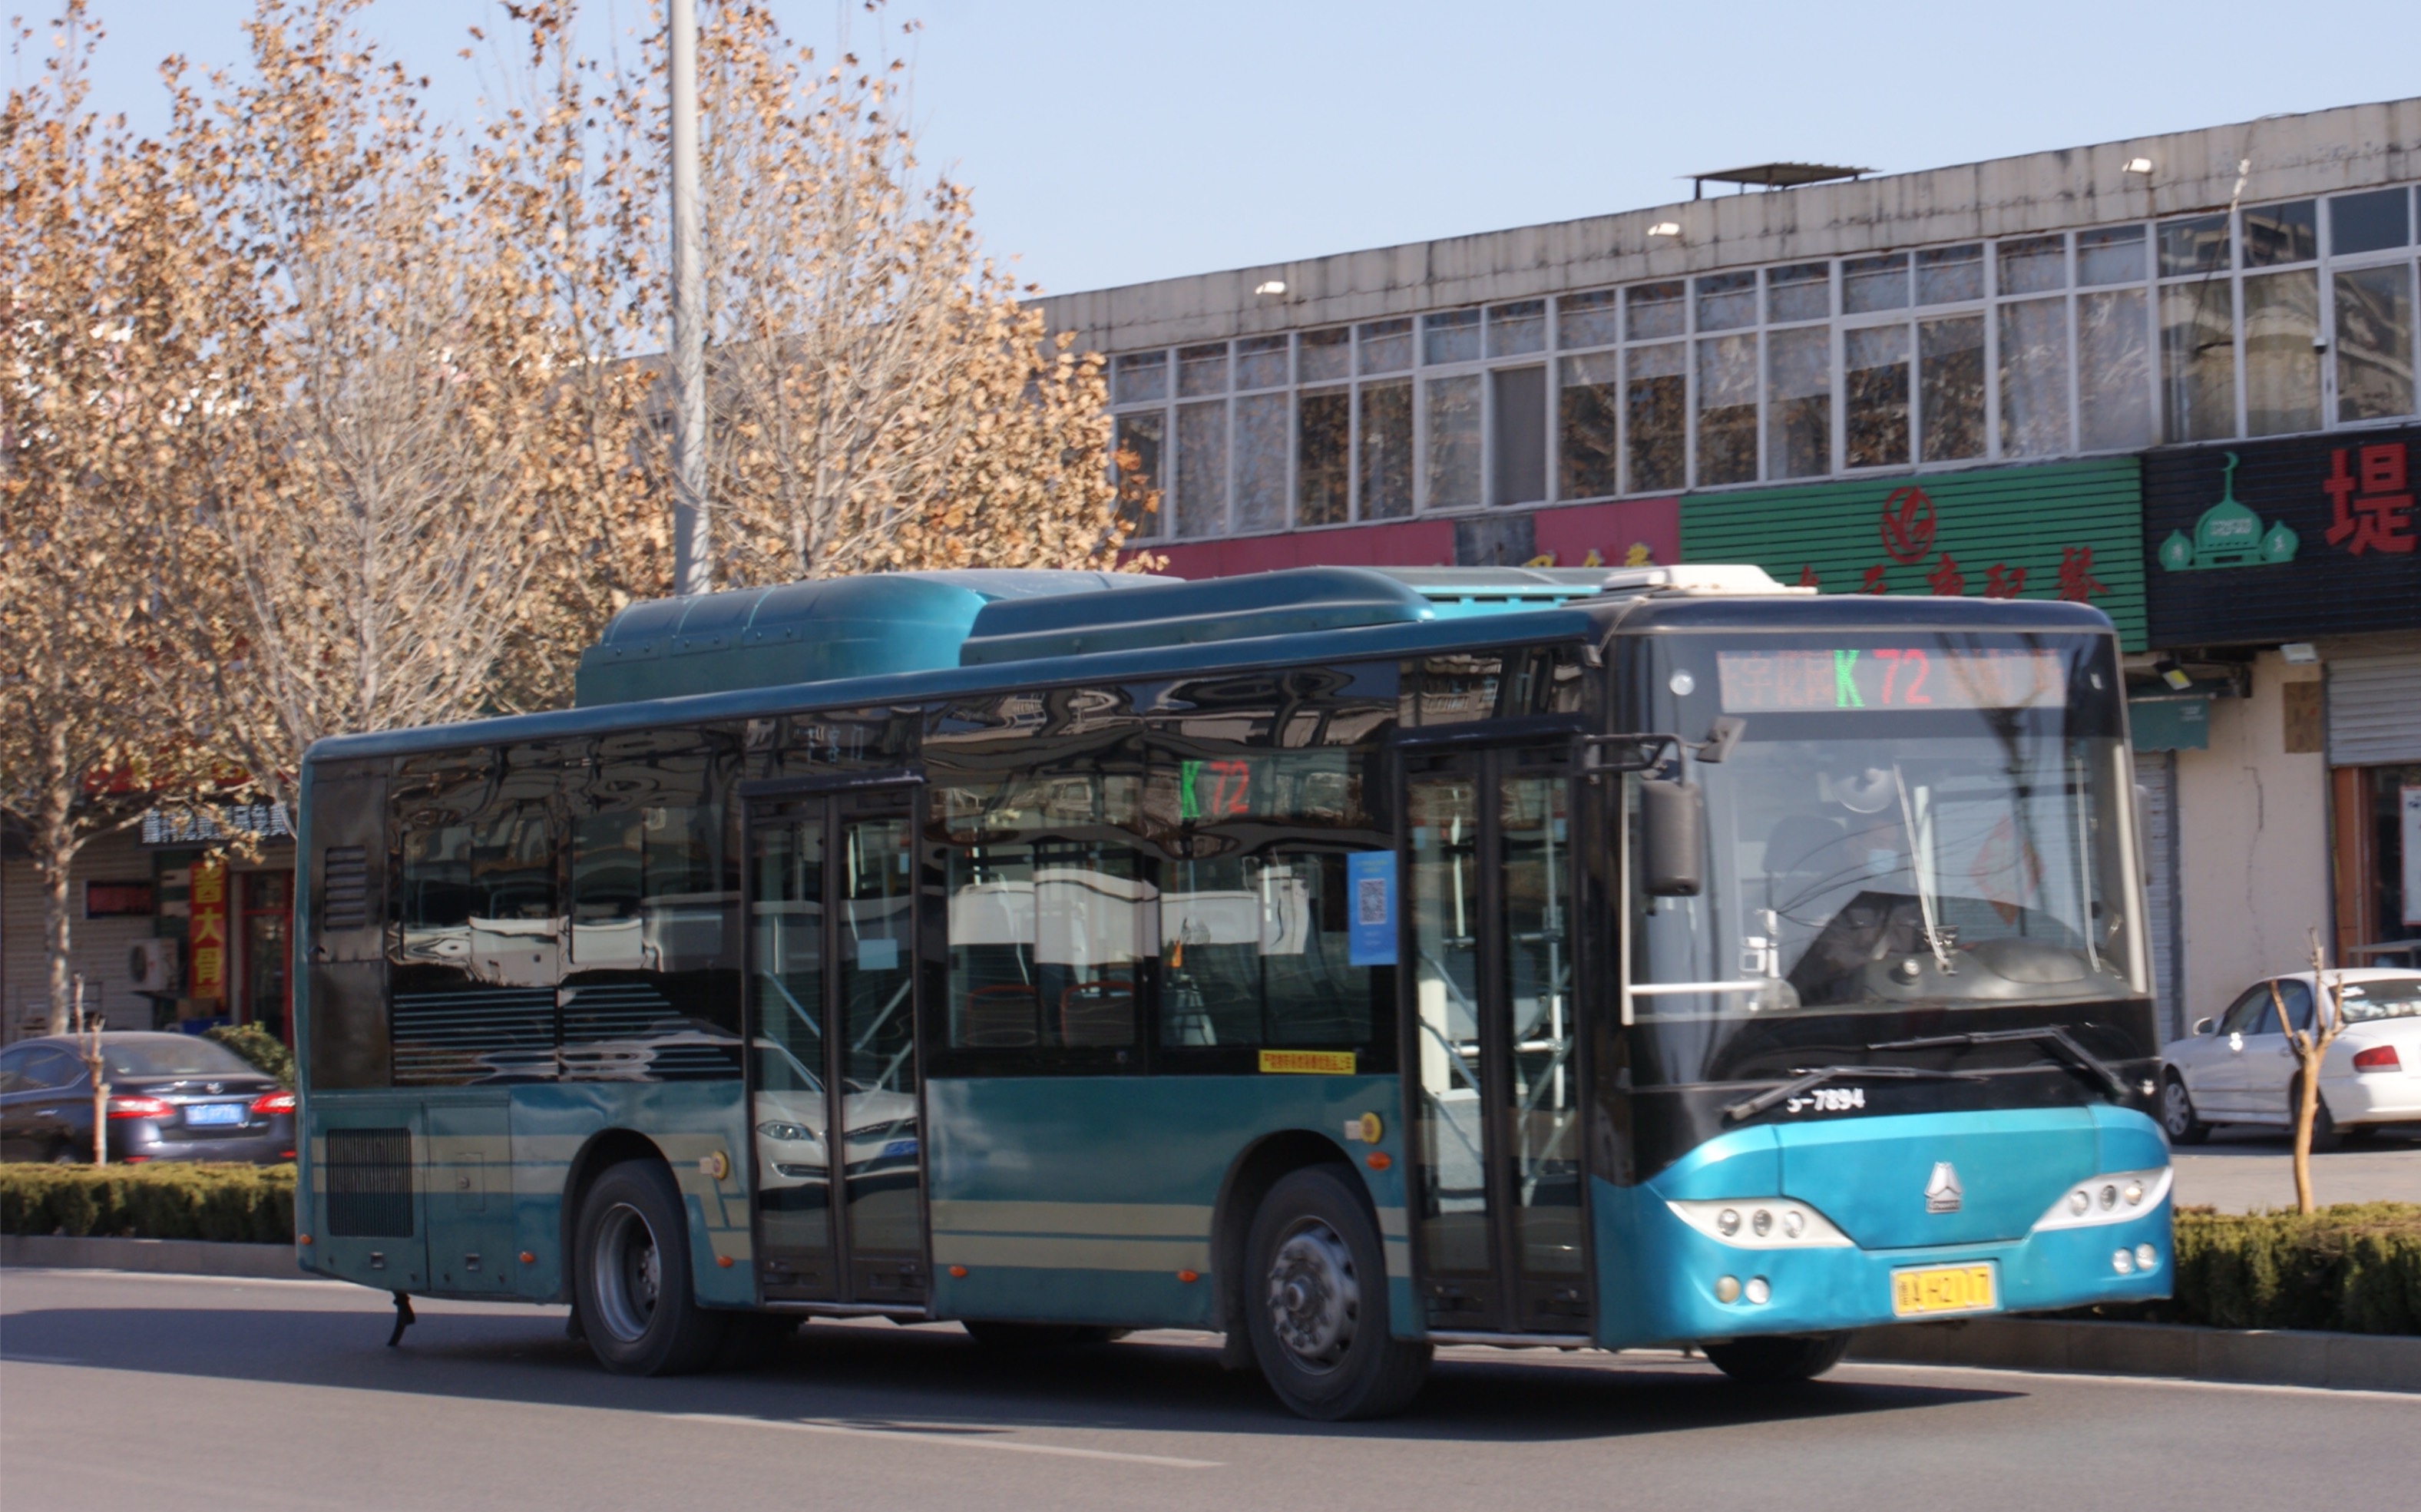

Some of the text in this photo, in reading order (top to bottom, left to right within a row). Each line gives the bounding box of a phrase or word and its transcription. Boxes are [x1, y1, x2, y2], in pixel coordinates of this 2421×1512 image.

[2323, 442, 2416, 558] 堤
[1833, 650, 1865, 707] K
[1872, 648, 1932, 705] 72
[1181, 759, 1249, 818] K 72
